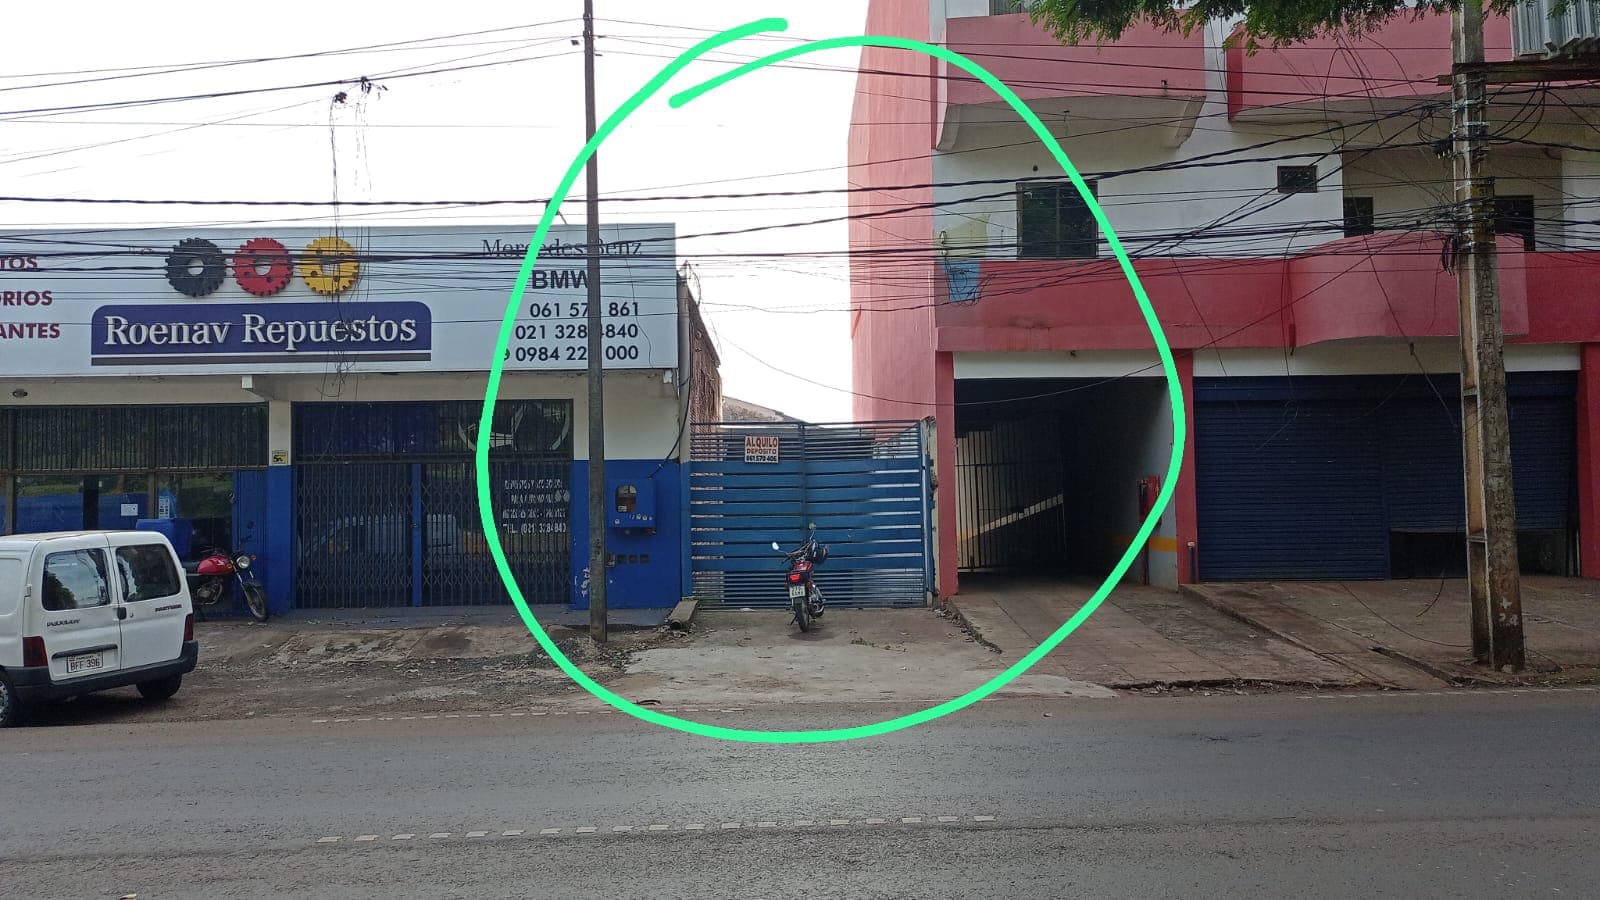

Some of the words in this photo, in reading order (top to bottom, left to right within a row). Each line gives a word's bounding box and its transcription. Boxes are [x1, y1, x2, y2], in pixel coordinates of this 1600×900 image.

[531, 270, 588, 290] BMW
[0, 290, 53, 306] RIOS
[530, 303, 560, 318] 061
[608, 302, 638, 317] 861
[104, 315, 231, 346] Roenav
[242, 313, 417, 351] Repuestos
[515, 325, 546, 340] 021
[554, 324, 588, 339] 328
[515, 346, 560, 361] 0984
[605, 345, 639, 361] 000
[746, 437, 778, 449] ALQUILO
